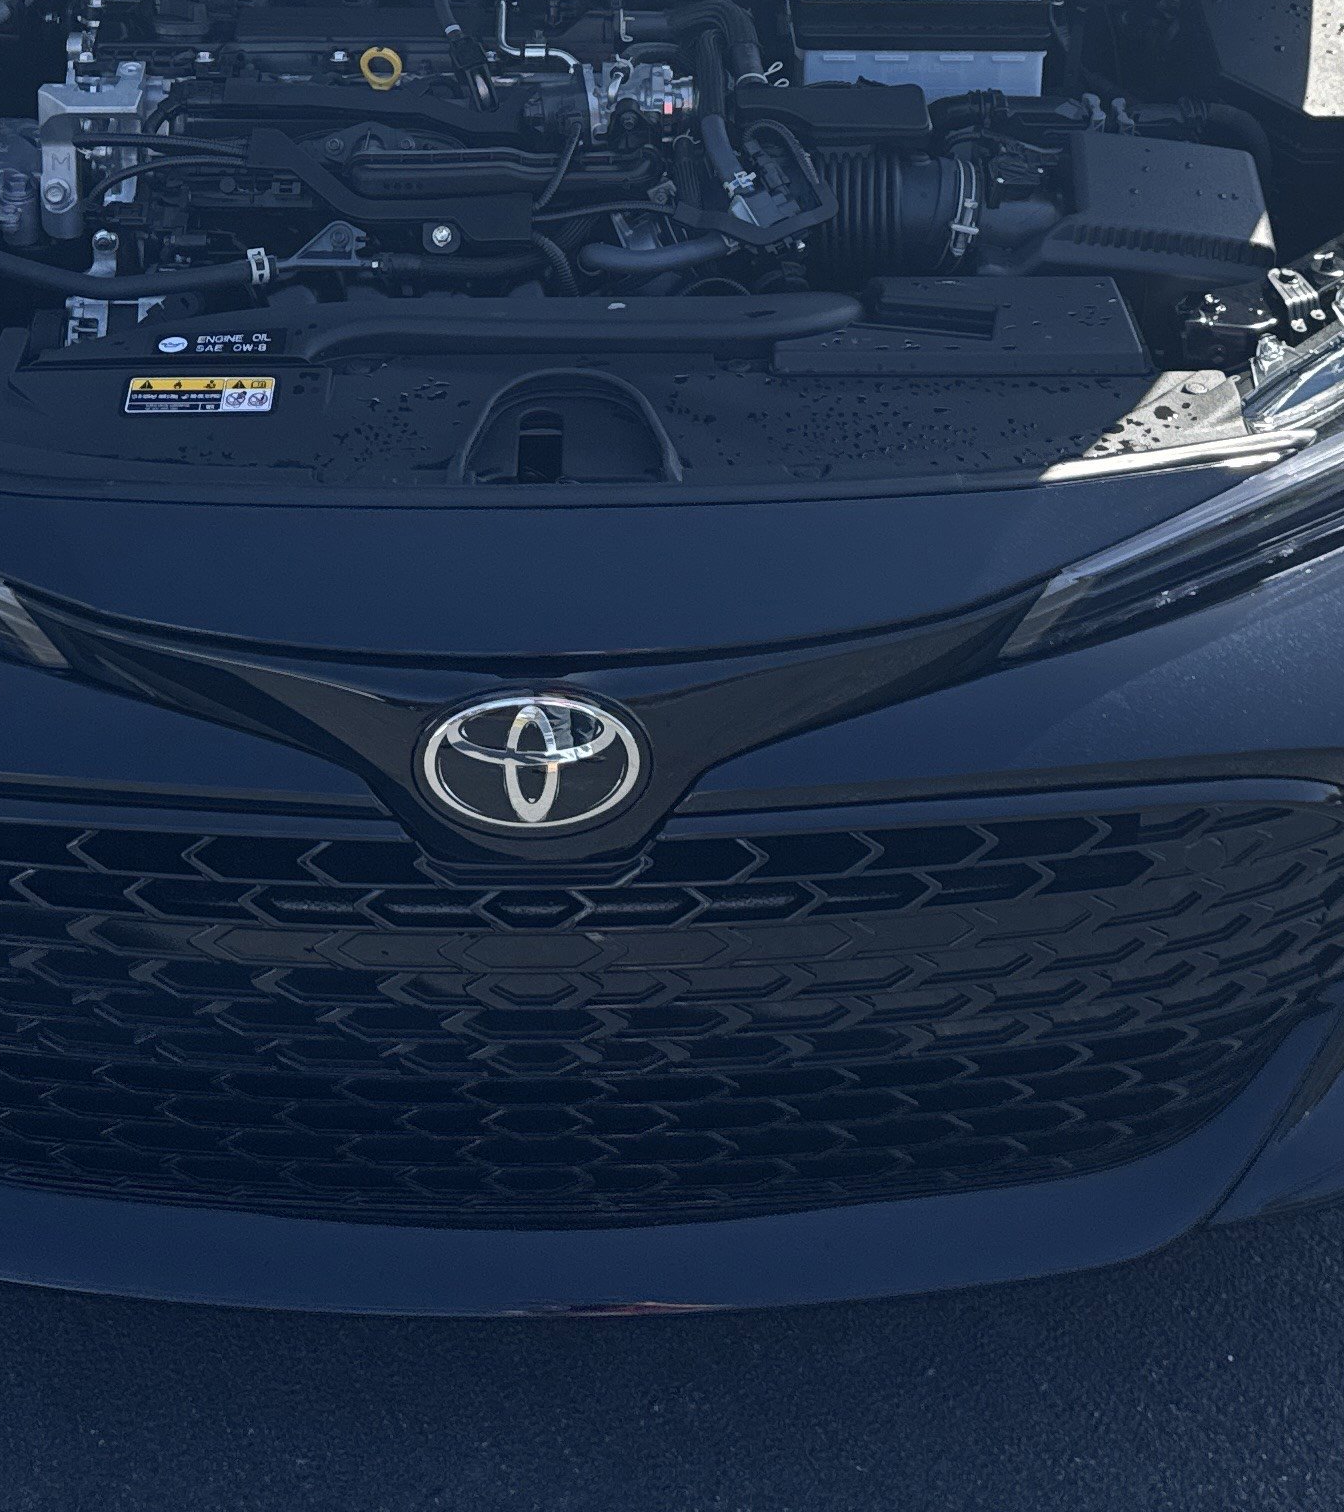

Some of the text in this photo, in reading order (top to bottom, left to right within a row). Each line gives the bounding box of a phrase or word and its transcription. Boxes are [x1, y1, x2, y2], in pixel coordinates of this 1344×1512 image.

[196, 333, 272, 344] ENGINE OIL
[195, 344, 224, 352] SAE
